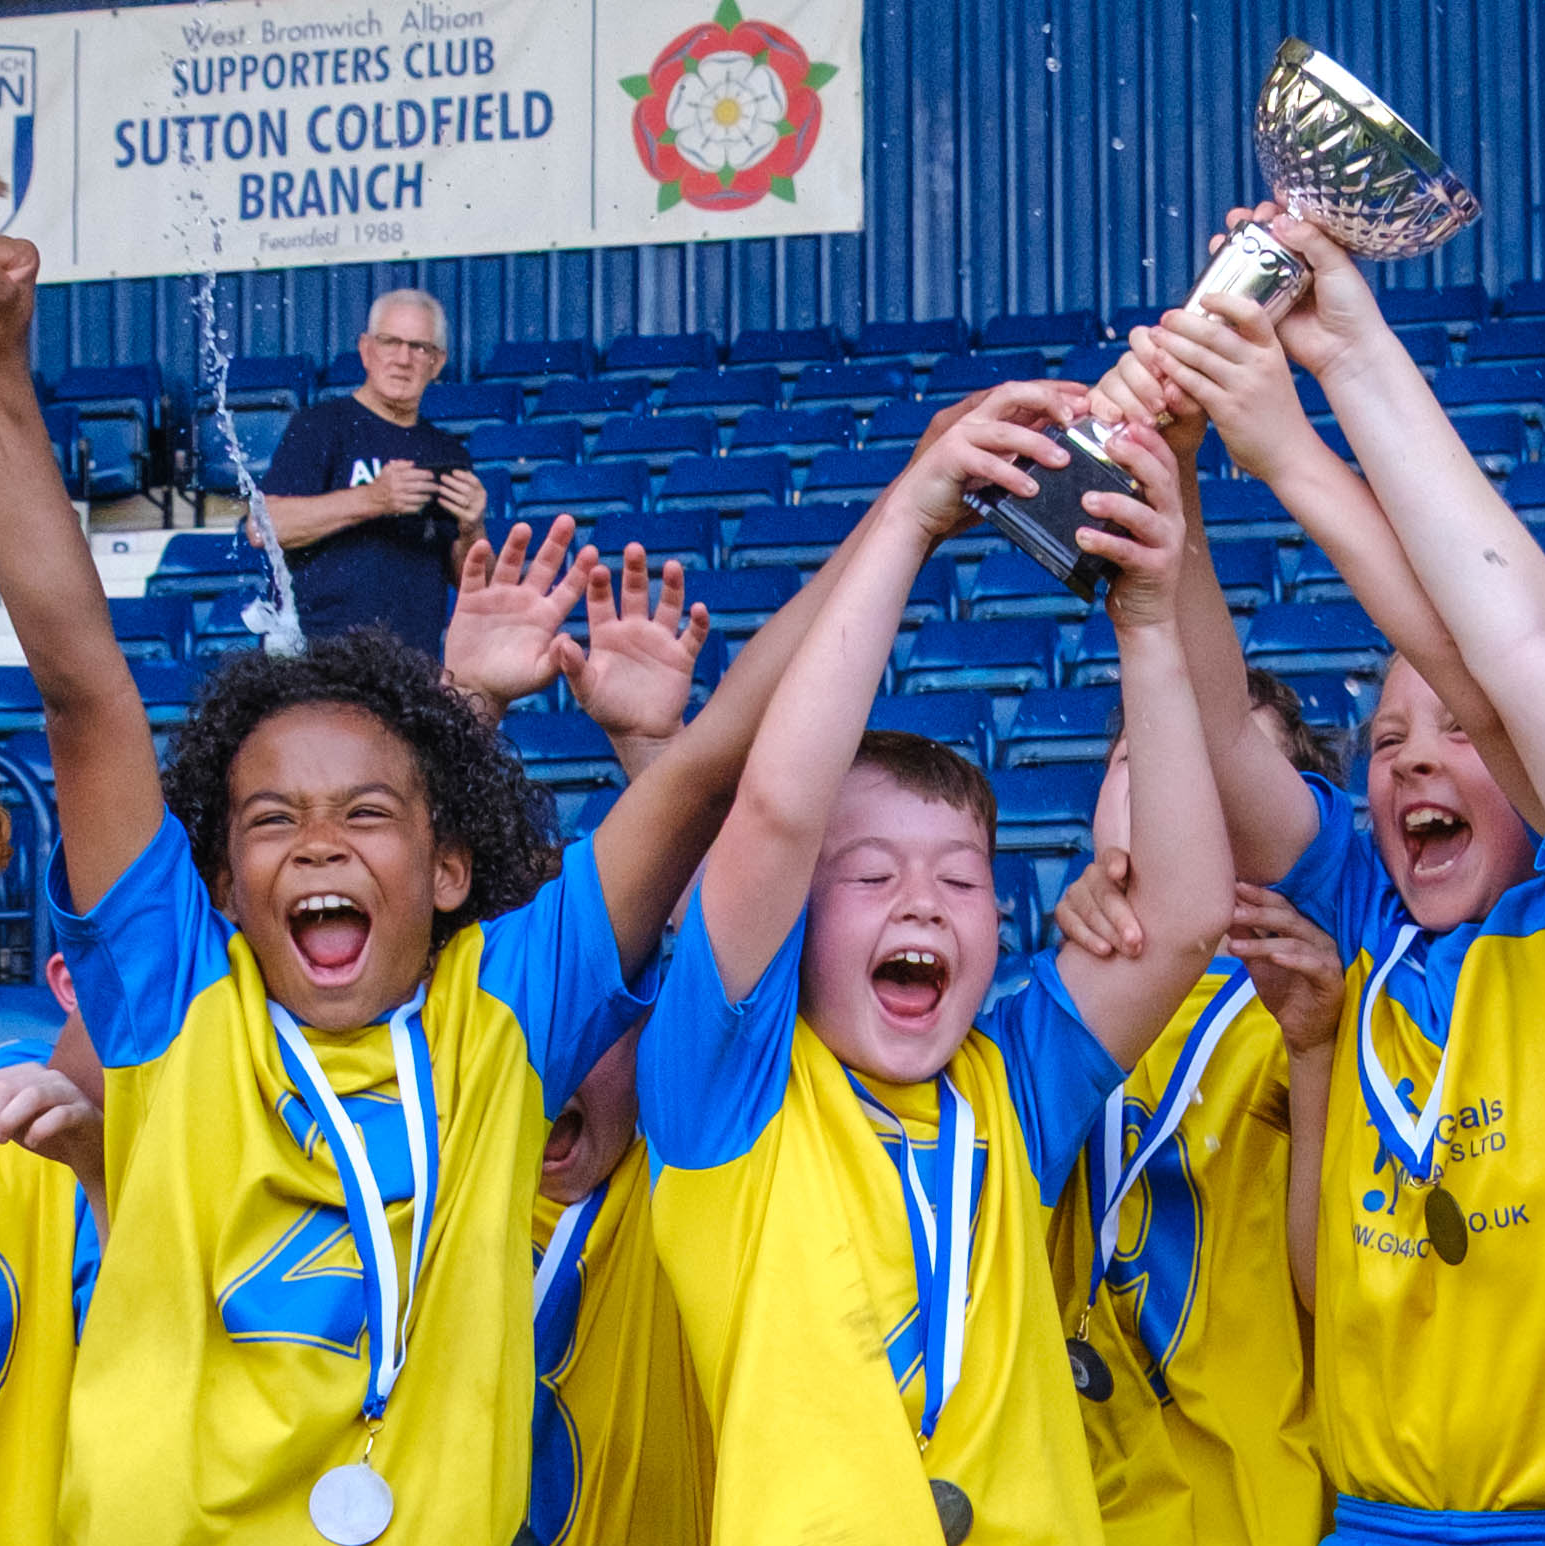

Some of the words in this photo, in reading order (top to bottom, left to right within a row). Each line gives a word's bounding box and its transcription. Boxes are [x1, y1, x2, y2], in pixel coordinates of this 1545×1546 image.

[182, 19, 247, 48] West
[261, 9, 383, 43] Bromwich
[400, 4, 485, 33] Albion
[172, 45, 390, 97] SUPPORTERS
[404, 37, 496, 80] CLUB
[114, 108, 288, 168] SUTTON
[307, 90, 555, 154] COLDFIELD
[239, 161, 424, 221] BRANCH
[258, 225, 340, 252] Founded
[354, 222, 405, 244] 1988
